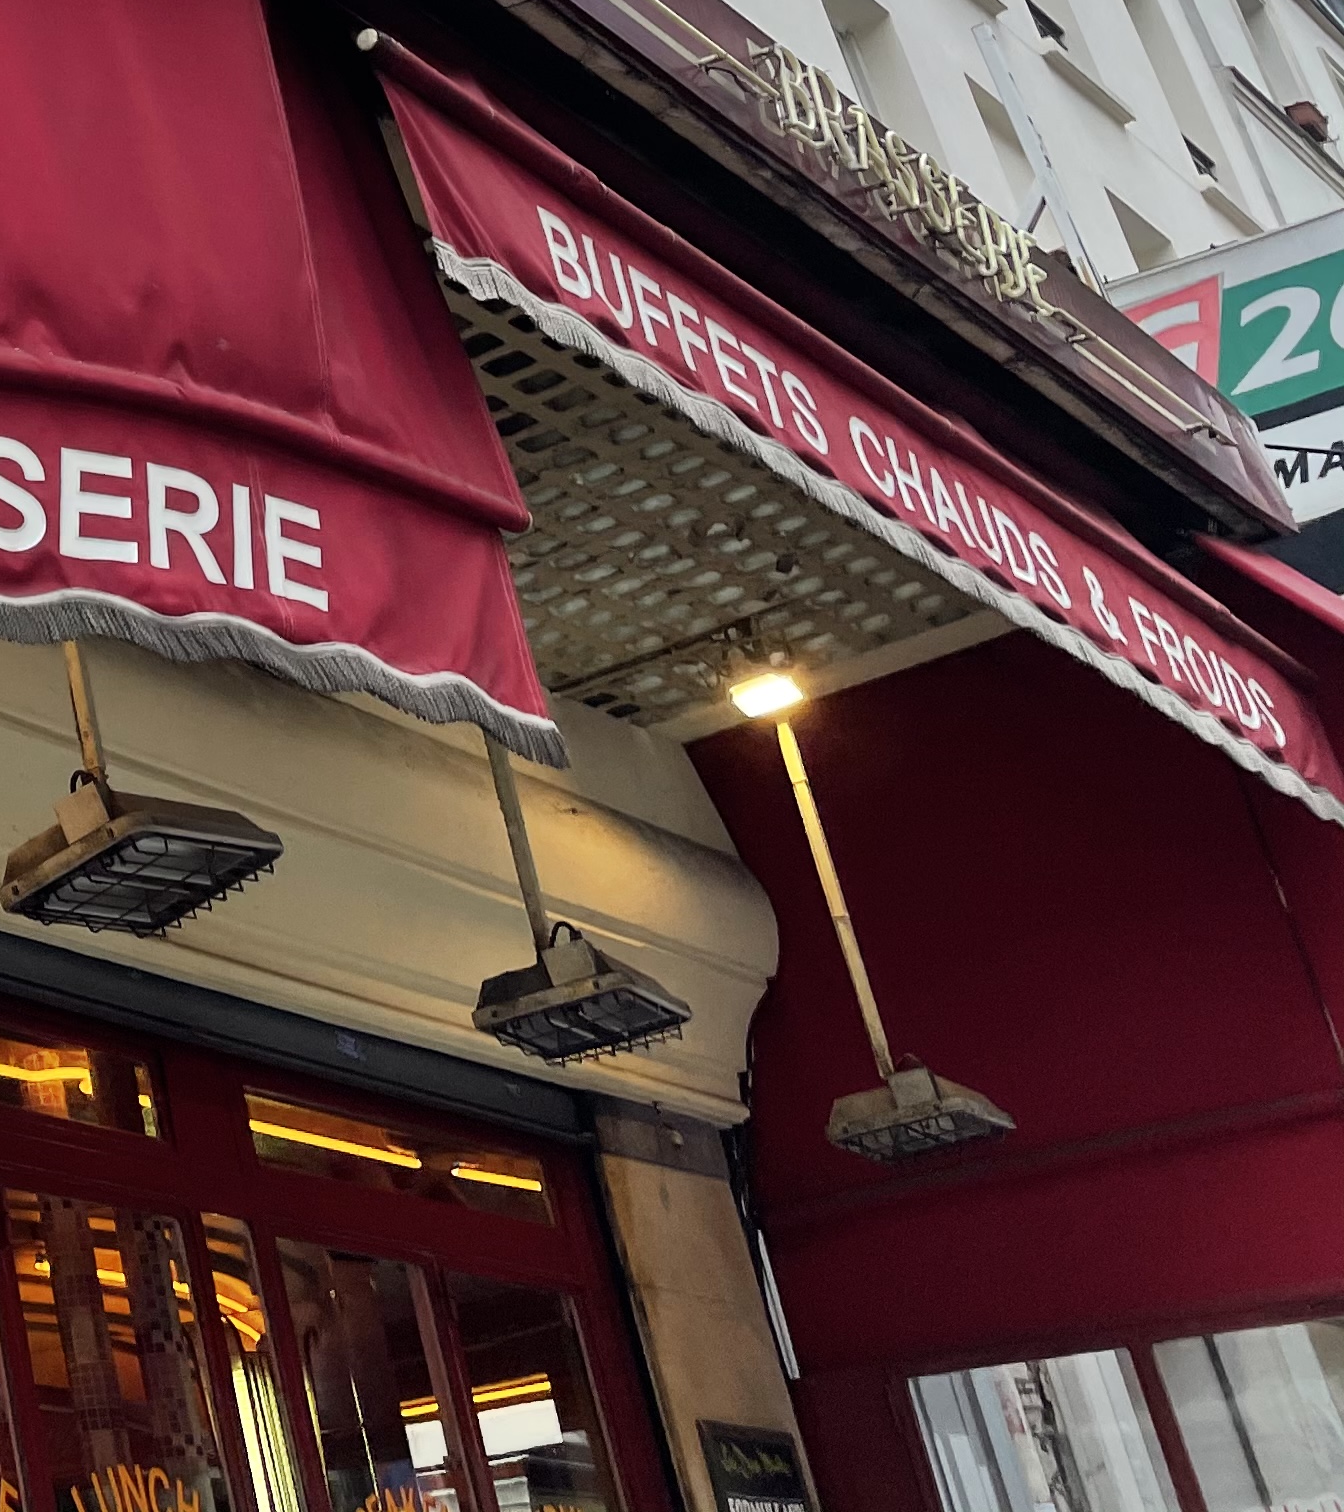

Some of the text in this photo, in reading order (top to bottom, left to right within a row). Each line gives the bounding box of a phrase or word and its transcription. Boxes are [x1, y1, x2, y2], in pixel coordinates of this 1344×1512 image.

[535, 205, 1287, 749] BUFFETS CHAUDS & FROIDS
